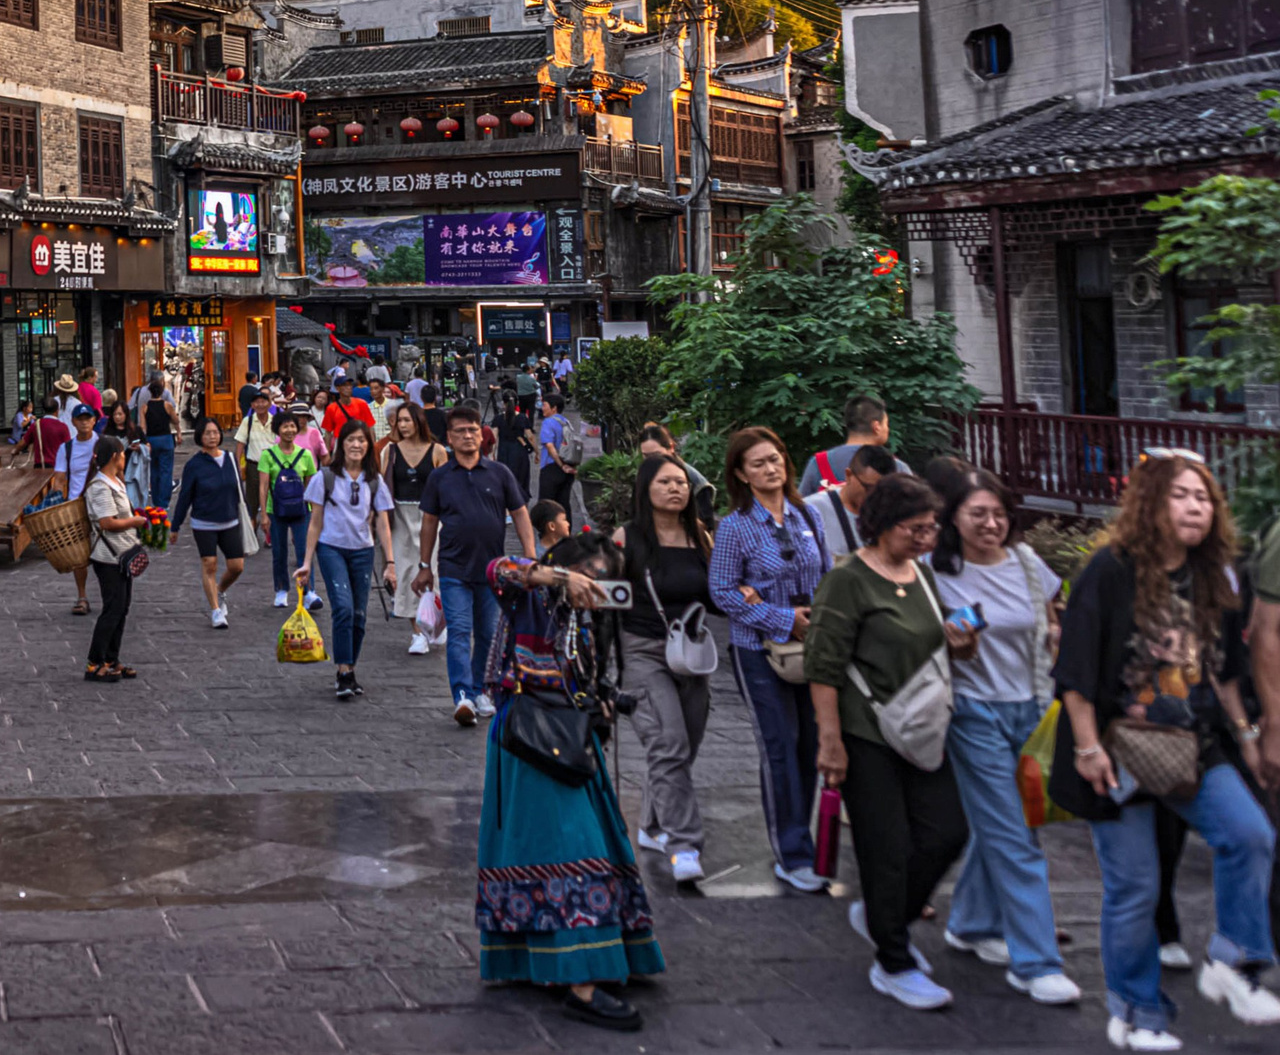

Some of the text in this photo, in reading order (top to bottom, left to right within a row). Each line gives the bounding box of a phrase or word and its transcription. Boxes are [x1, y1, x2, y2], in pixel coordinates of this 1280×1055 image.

[302, 172, 487, 195] (神凤文化景区)游客中心
[487, 168, 562, 179] TOURIST CENTRE
[53, 240, 105, 274] 美宜佳
[558, 217, 575, 279] 观全景入口
